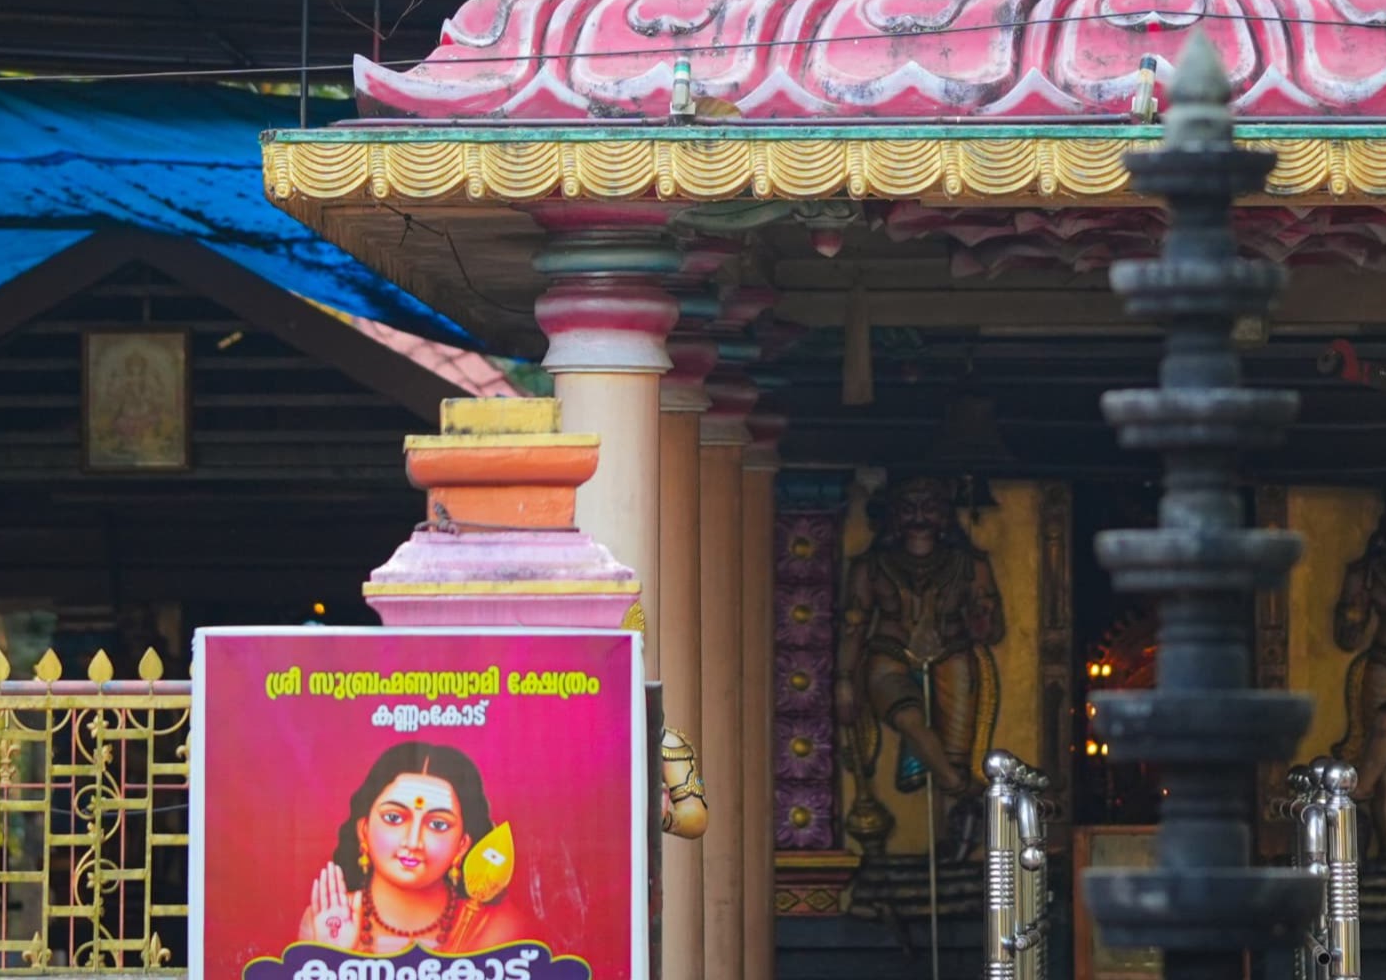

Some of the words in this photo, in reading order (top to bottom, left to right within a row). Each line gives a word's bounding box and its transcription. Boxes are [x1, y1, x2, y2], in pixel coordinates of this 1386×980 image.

[265, 665, 301, 700] ശ്രീ
[308, 665, 501, 700] സുബ്രഹ്മണ്യസ്വാമി
[507, 670, 600, 700] ക്ഷേത്രം
[371, 699, 490, 732] കണ്ണംകോട്
